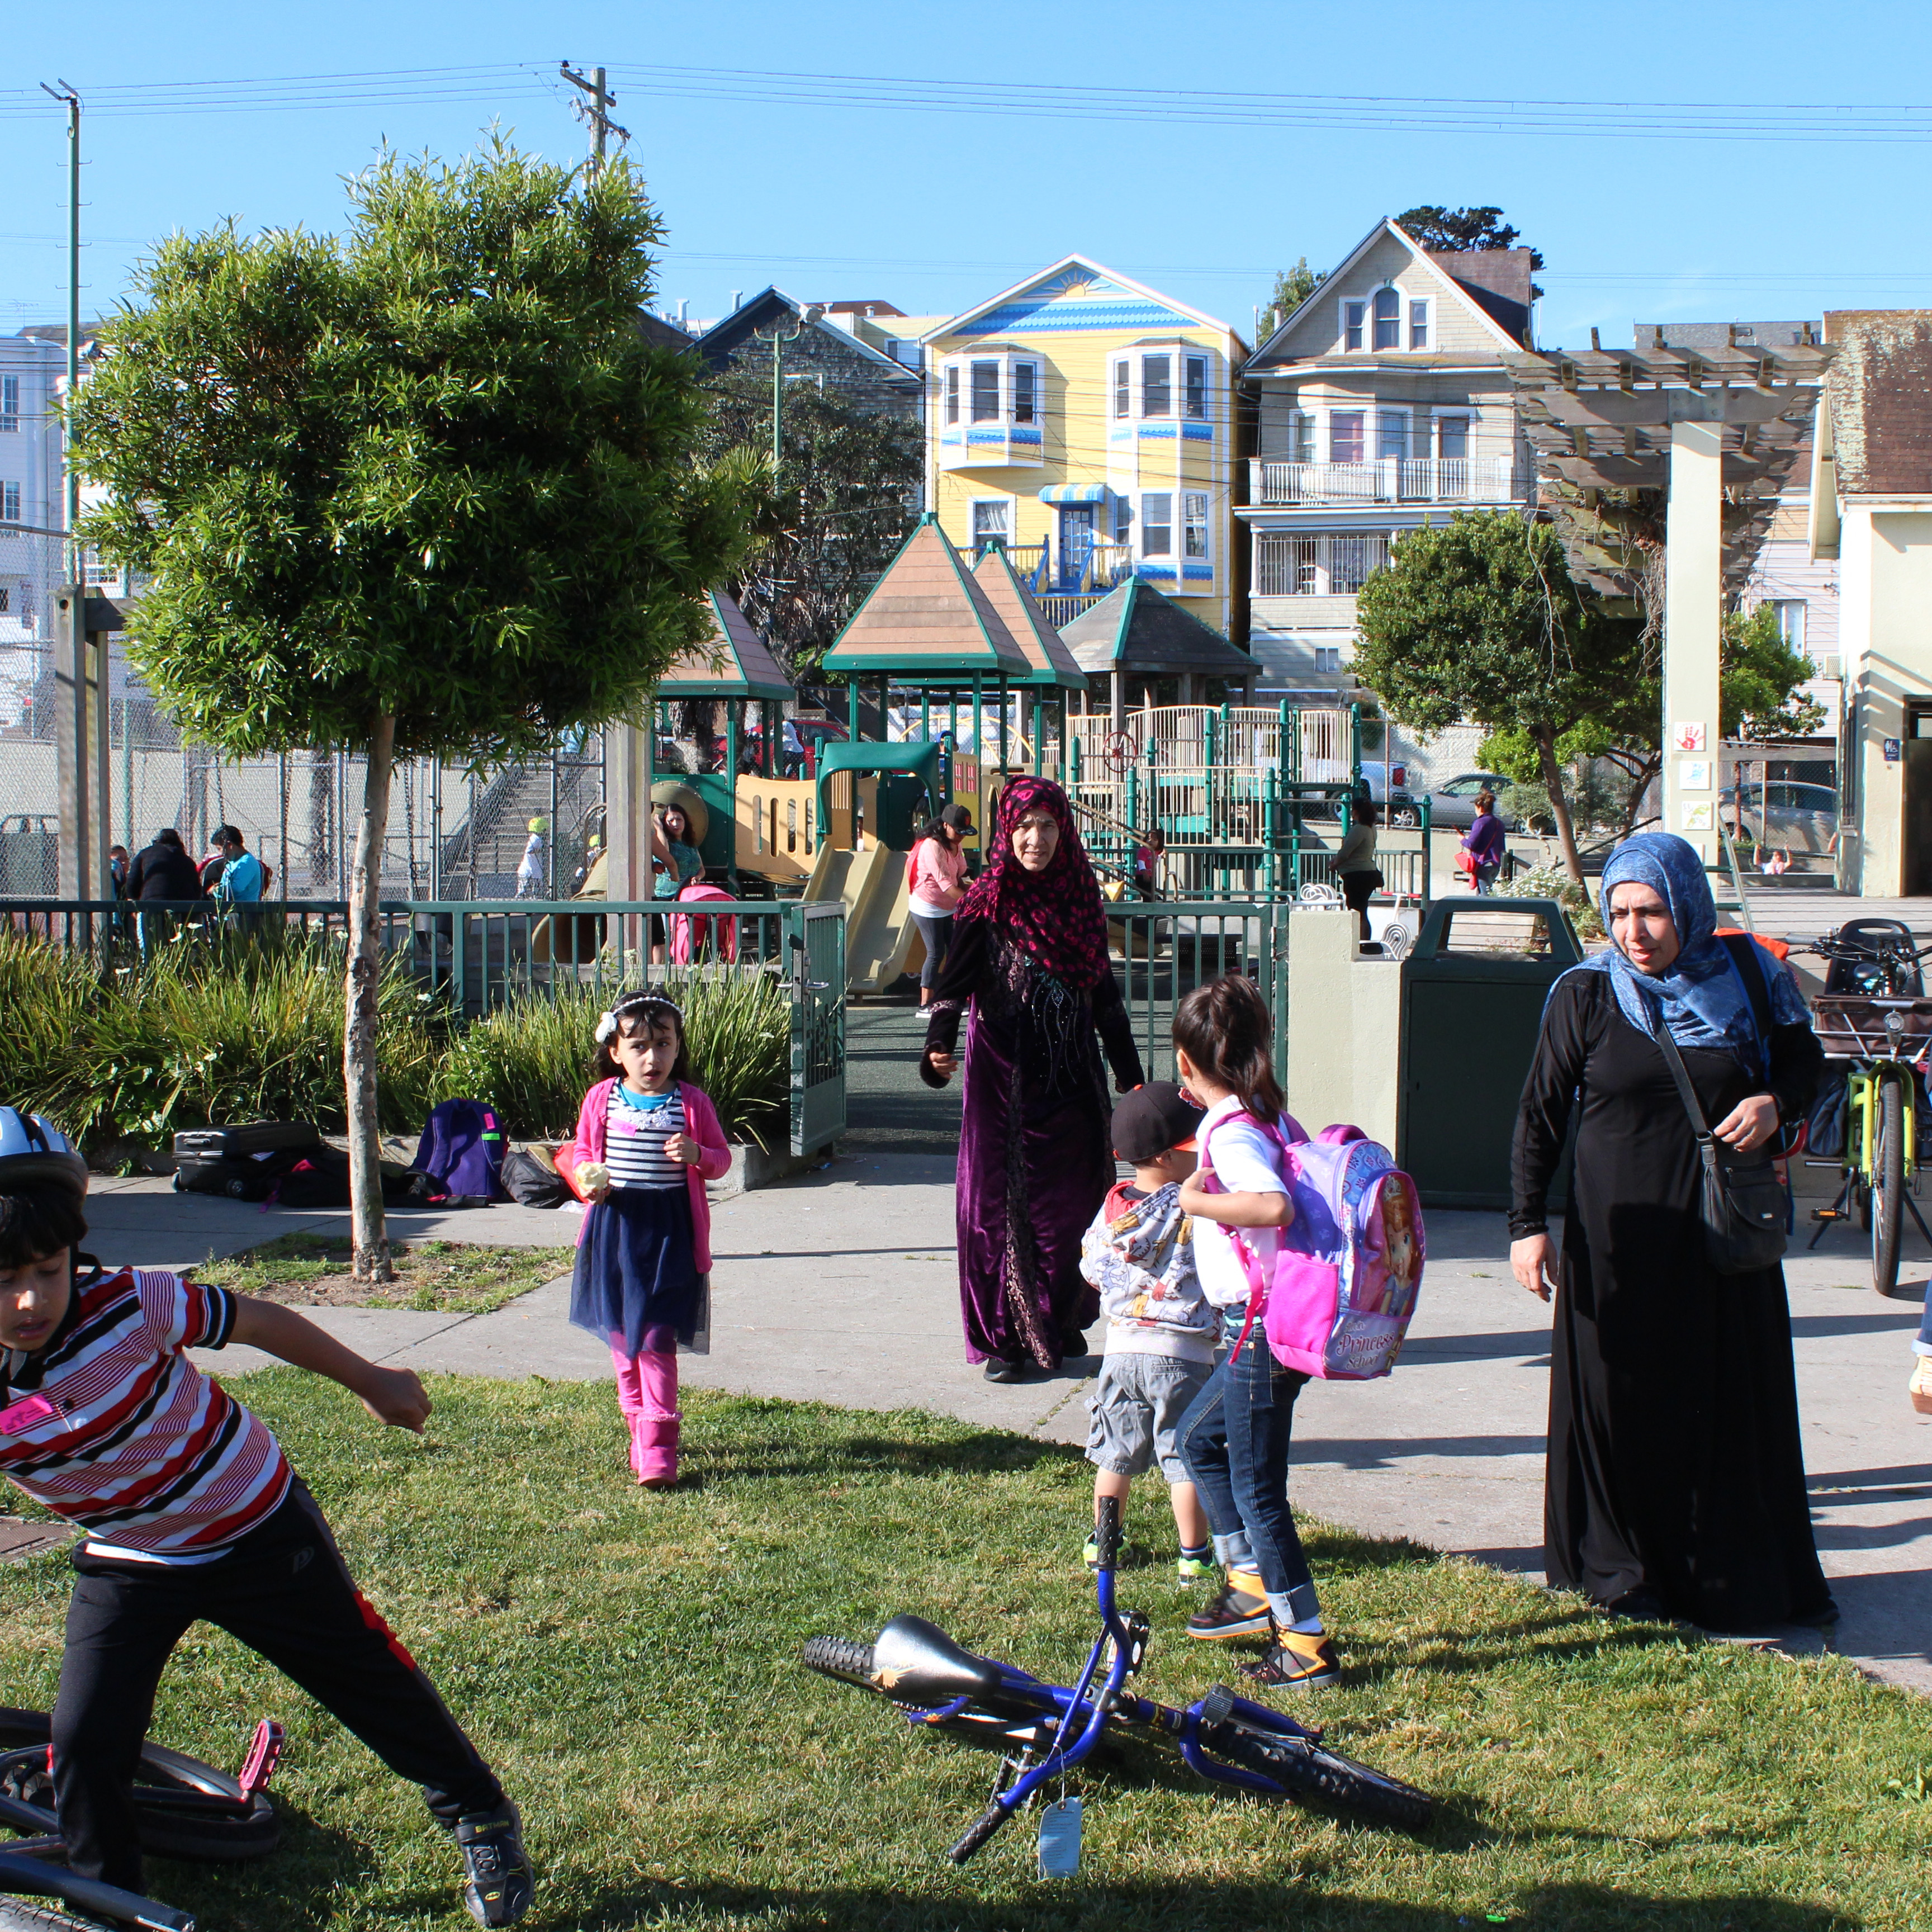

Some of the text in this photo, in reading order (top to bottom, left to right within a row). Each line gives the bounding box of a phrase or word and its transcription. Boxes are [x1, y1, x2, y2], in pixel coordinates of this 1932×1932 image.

[1336, 1332, 1395, 1356] Princess
[1346, 1352, 1381, 1370] School
[475, 1819, 509, 1834] BATMAN
